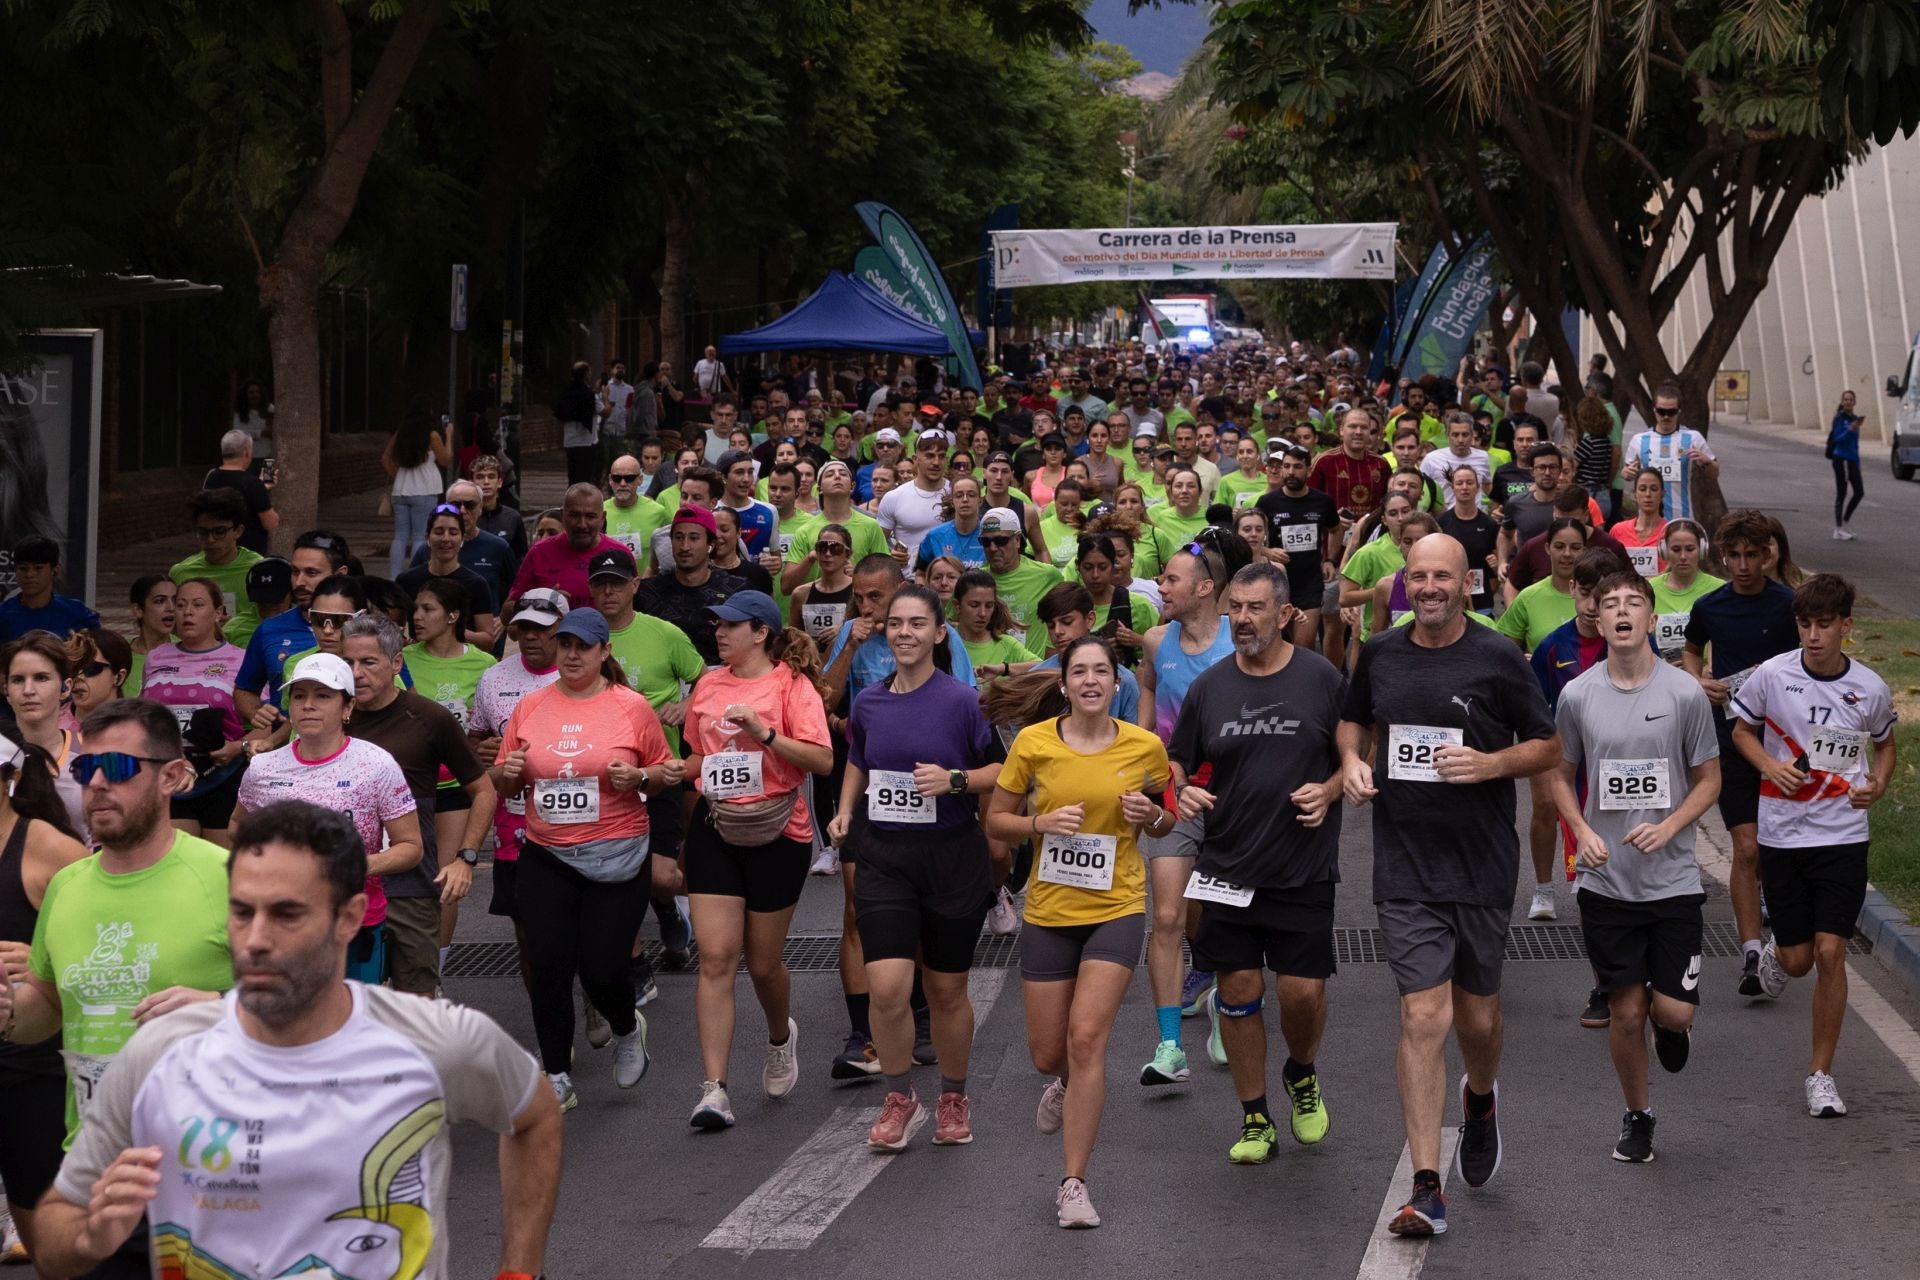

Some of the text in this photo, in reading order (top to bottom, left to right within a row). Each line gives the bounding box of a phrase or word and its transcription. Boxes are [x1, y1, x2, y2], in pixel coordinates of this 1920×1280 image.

[1098, 229, 1296, 248] Carrera de la Prensa
[1062, 254, 1082, 263] con
[1084, 251, 1121, 262] motivo
[1123, 250, 1139, 261] del
[1160, 249, 1200, 260] Mundial
[1202, 249, 1215, 259] de
[1217, 249, 1227, 259] la
[1229, 248, 1272, 258] Libertad
[1275, 248, 1288, 257] de
[1290, 248, 1325, 258] Prensa
[1287, 533, 1312, 545] 354
[813, 615, 833, 628] 48
[1785, 684, 1804, 694] vive
[1808, 706, 1832, 725] 17
[561, 723, 583, 734] RUN
[557, 739, 579, 751] FUN
[1813, 739, 1860, 759] 1118
[708, 766, 751, 787] 185
[1608, 776, 1658, 795] 926
[542, 792, 589, 810] 990
[878, 787, 924, 808] 935
[1047, 846, 1106, 870] 1000
[244, 1119, 264, 1132] 1/2
